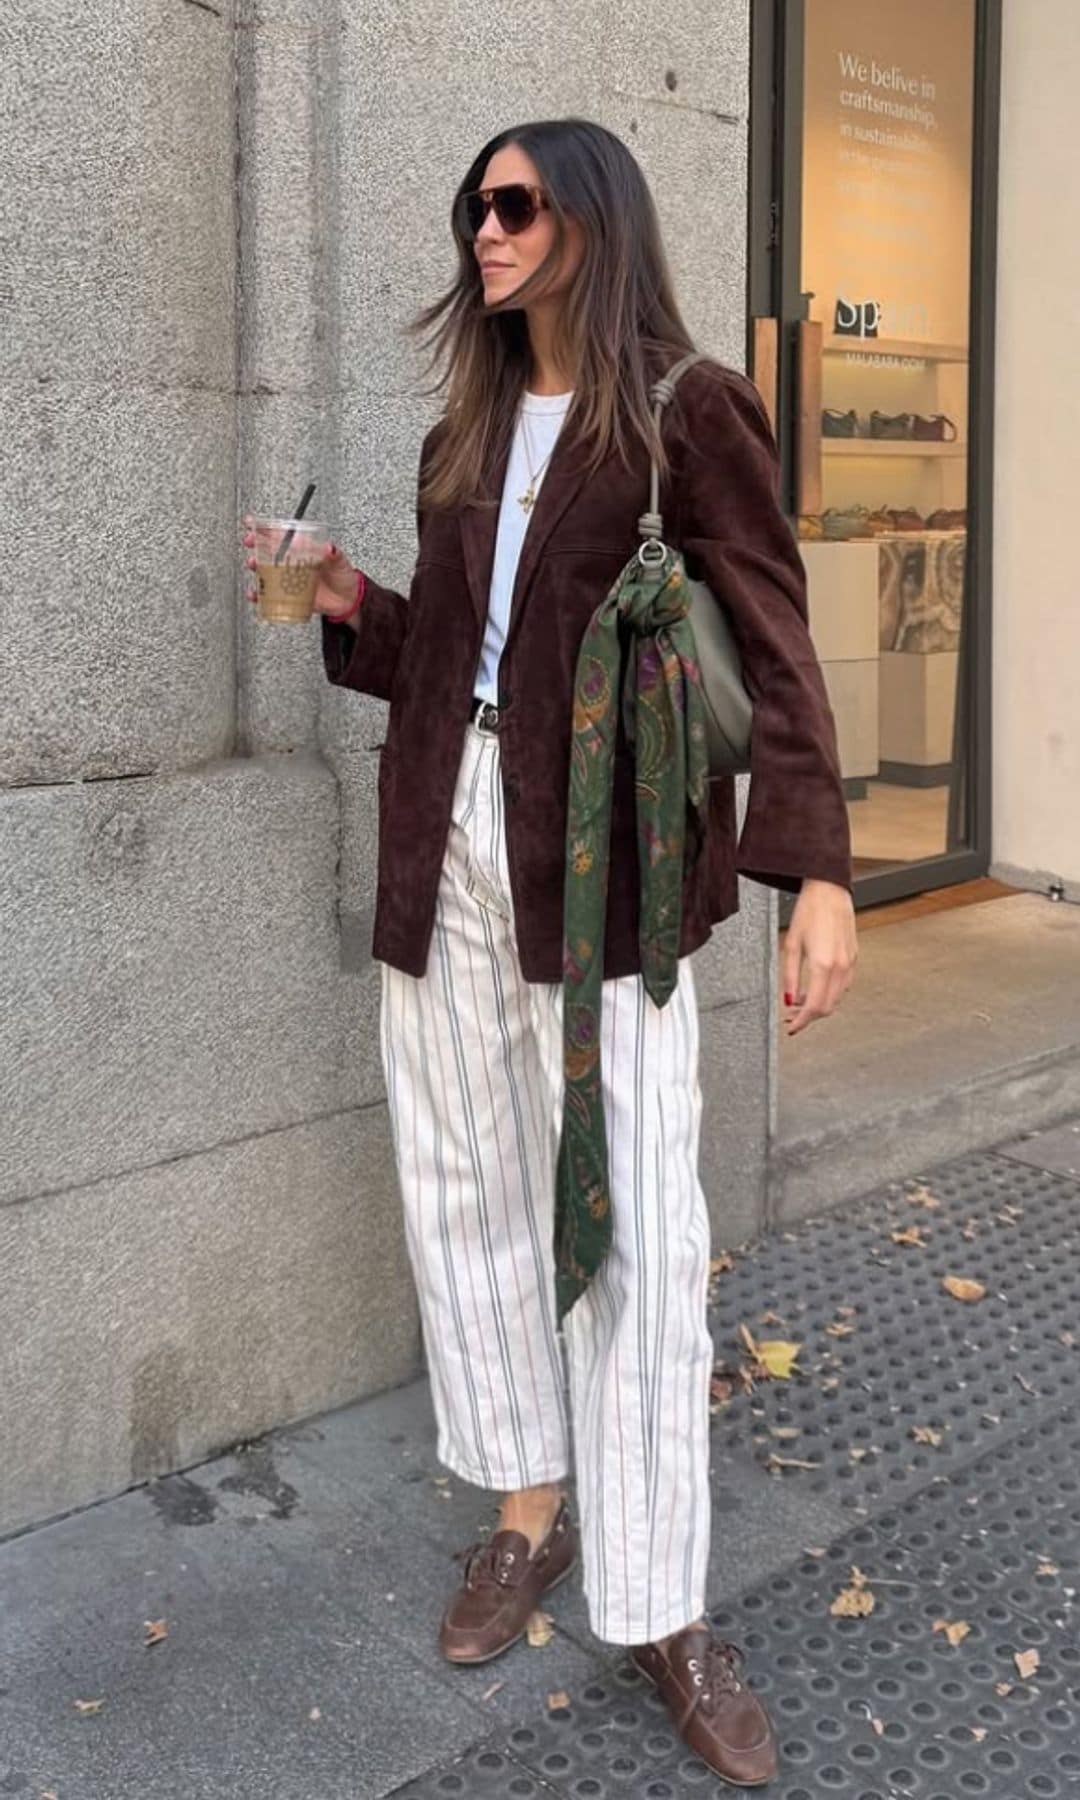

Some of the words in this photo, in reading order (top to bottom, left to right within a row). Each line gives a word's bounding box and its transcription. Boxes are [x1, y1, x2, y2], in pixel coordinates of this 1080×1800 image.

[838, 51, 867, 82] We
[871, 61, 919, 96] belive
[921, 74, 936, 102] in
